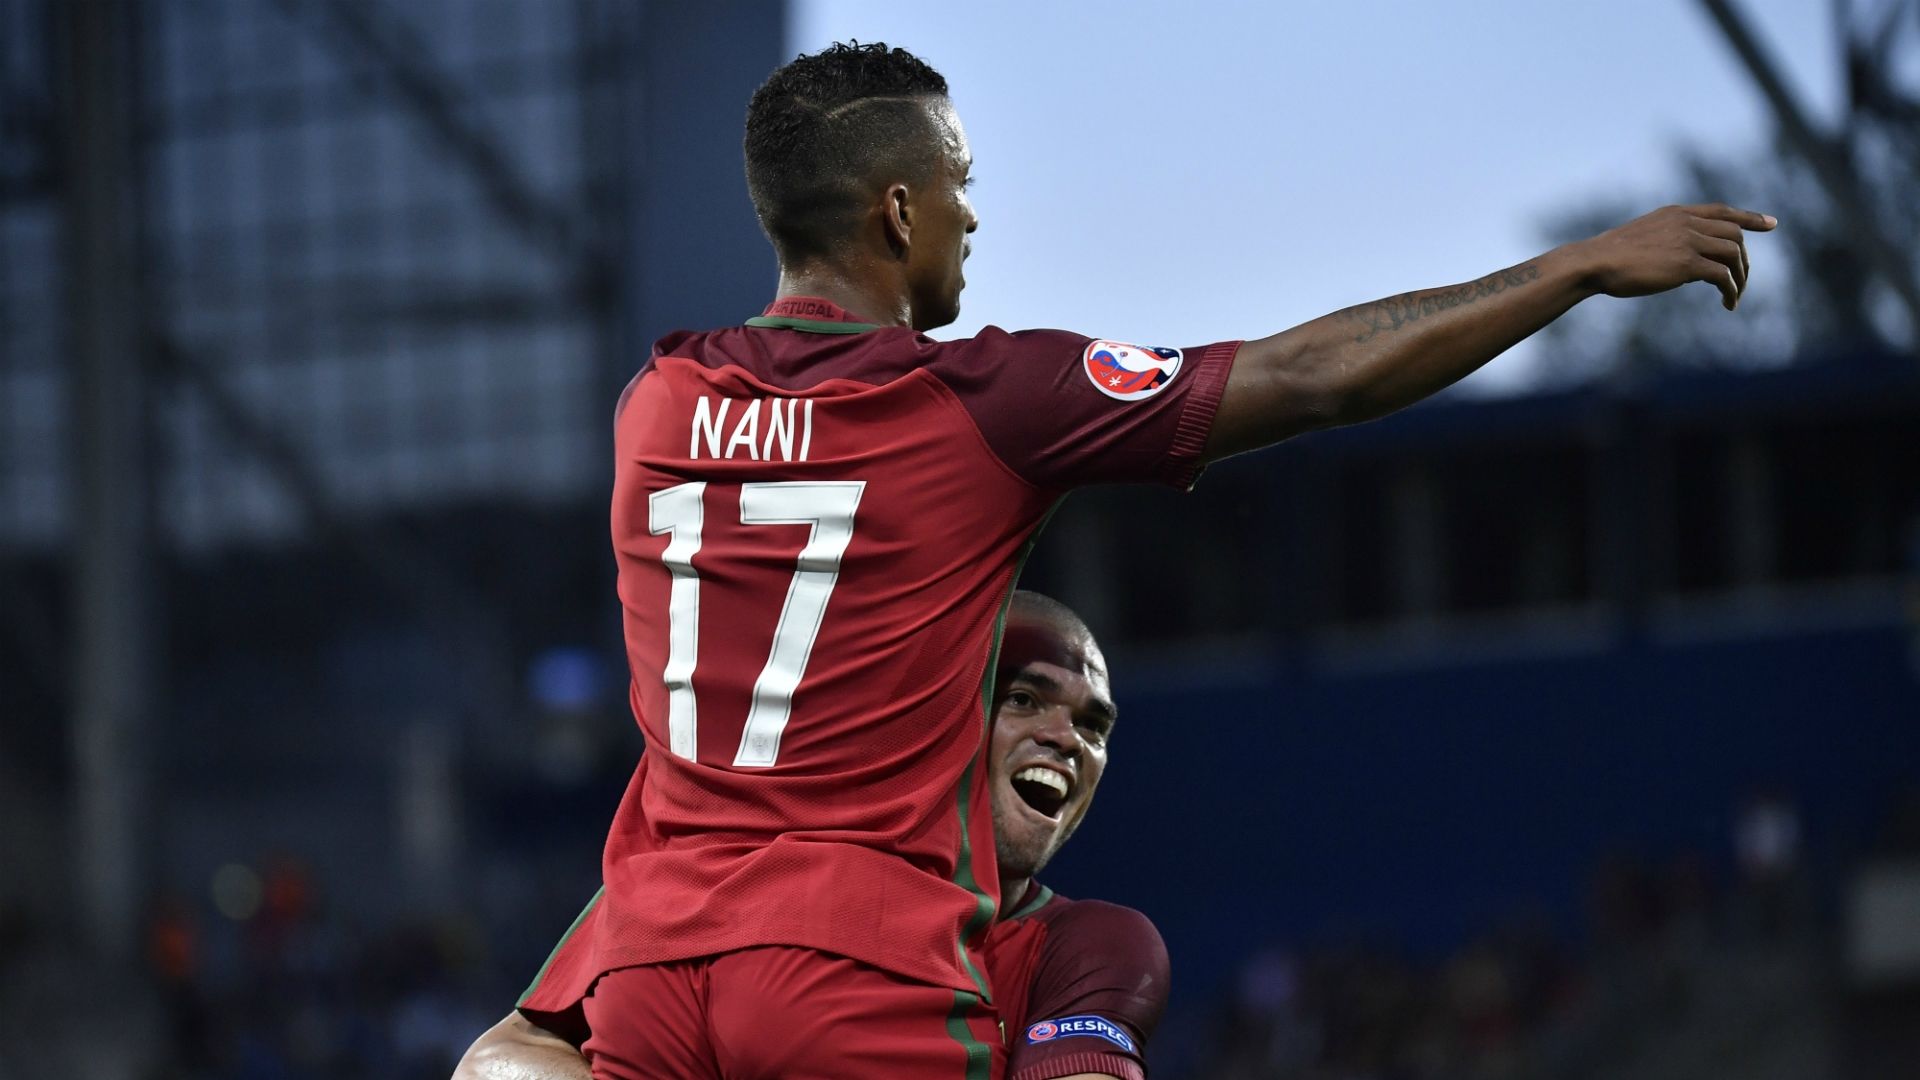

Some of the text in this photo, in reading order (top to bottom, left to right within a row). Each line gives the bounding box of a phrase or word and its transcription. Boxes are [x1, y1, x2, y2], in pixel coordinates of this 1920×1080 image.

[690, 396, 813, 462] NANI
[648, 481, 867, 767] 17
[1060, 1020, 1133, 1052] RESPECT
